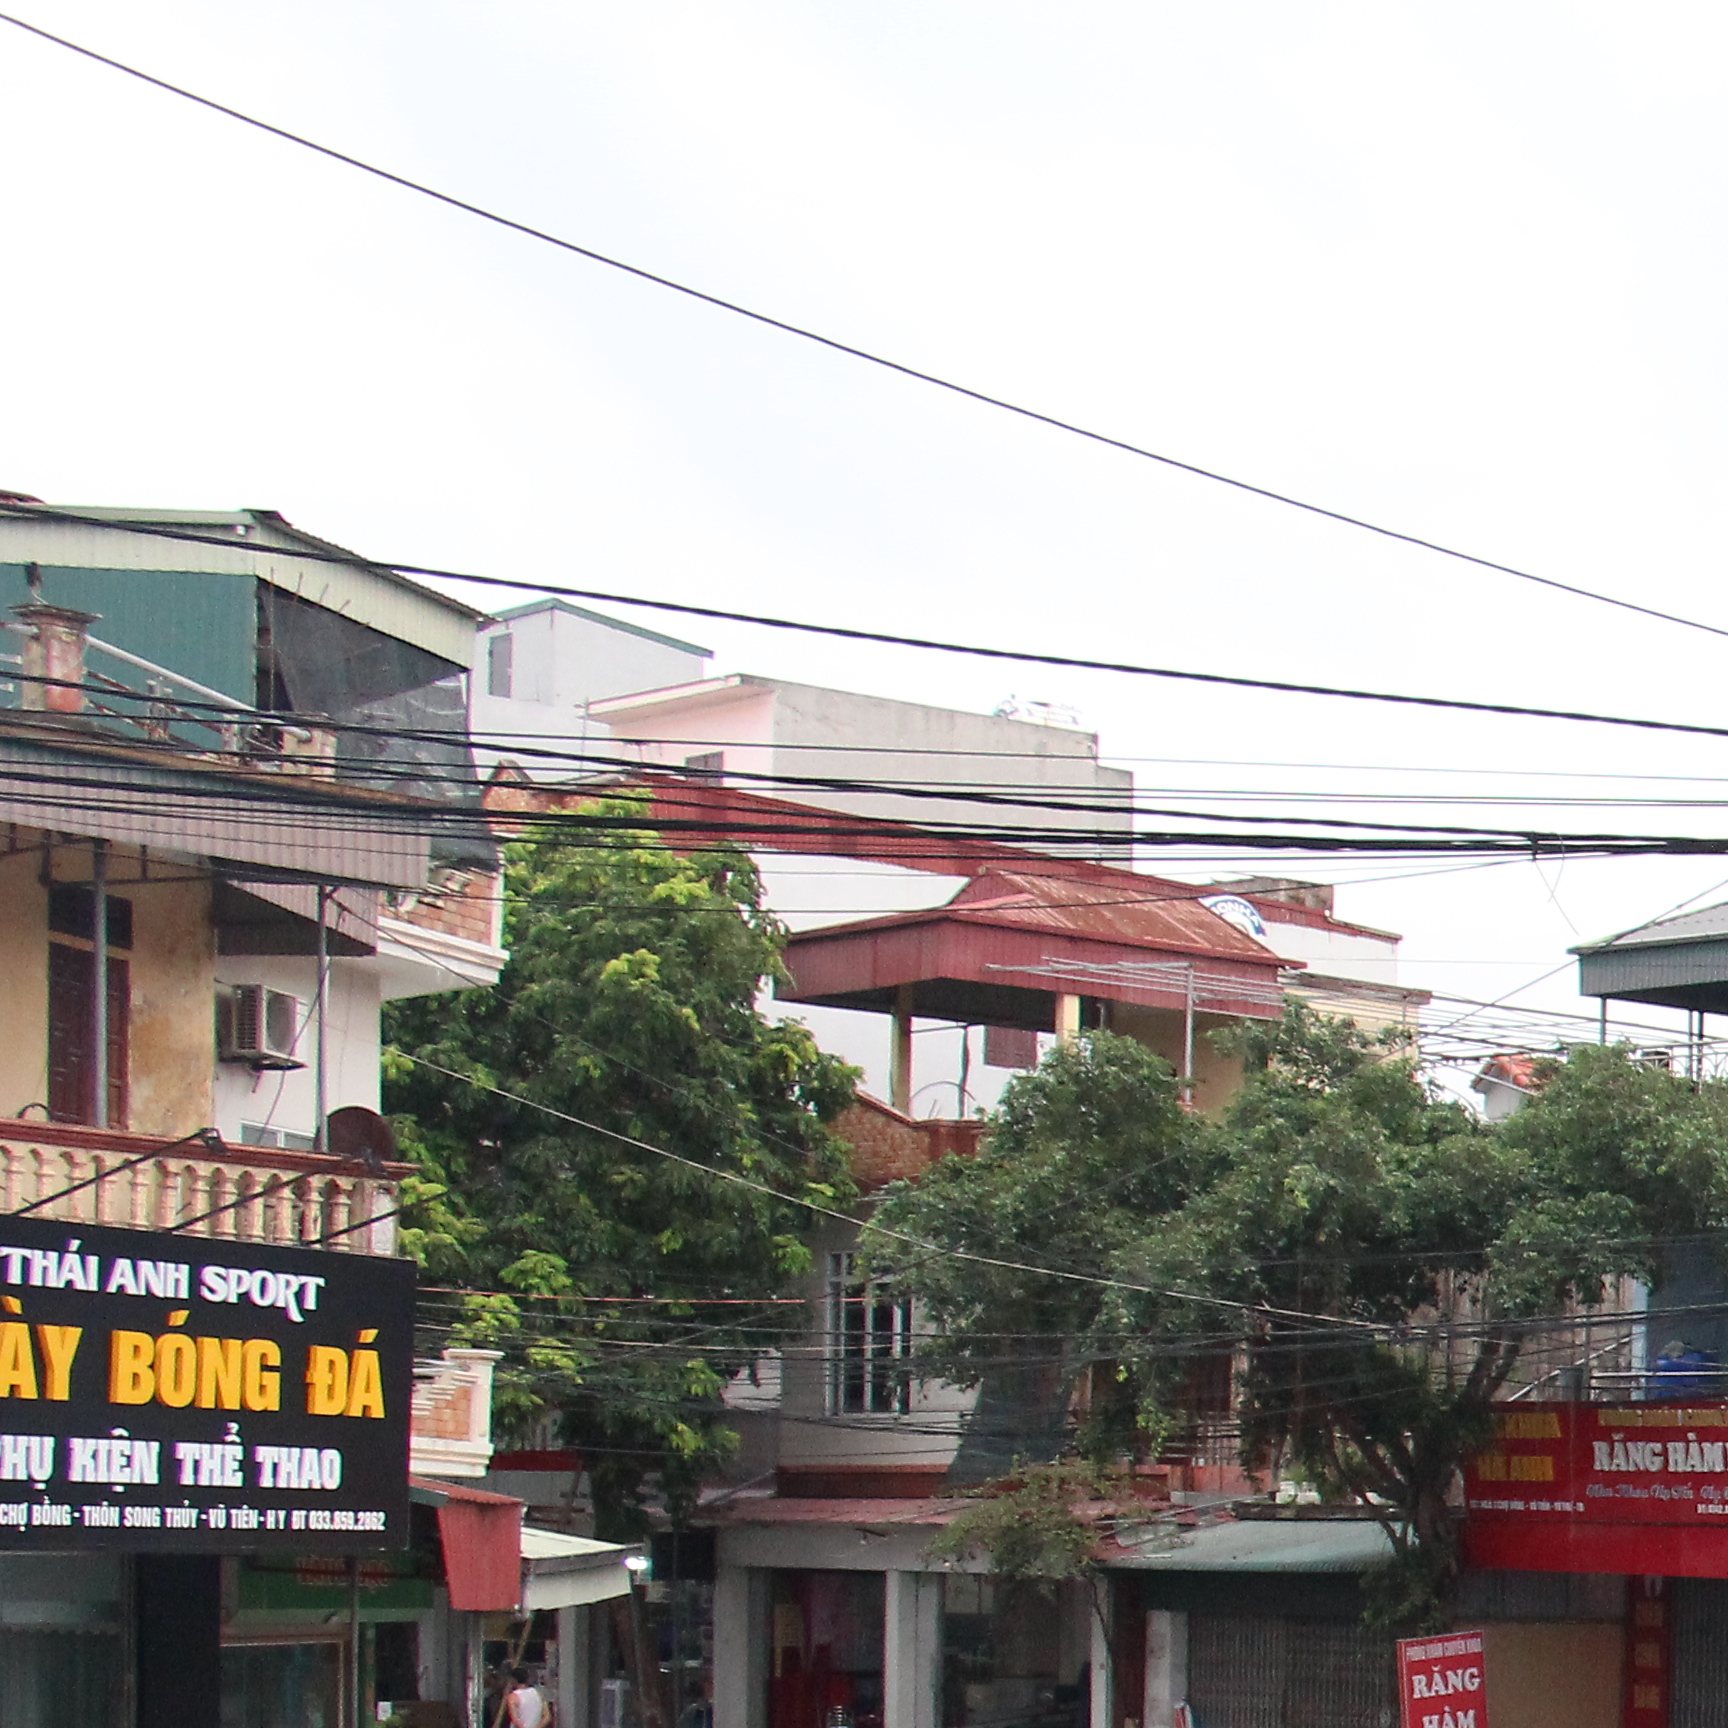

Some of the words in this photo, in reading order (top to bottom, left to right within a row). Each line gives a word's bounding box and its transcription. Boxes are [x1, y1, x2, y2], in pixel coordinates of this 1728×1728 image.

[0, 1238, 99, 1292] THÁI
[106, 1256, 190, 1299] ANH
[200, 1264, 325, 1322] SPORT
[108, 1309, 282, 1411] BÓNG
[305, 1328, 385, 1418] ĐÁ
[67, 1427, 160, 1492] KIỆN
[175, 1421, 244, 1487] THỂ
[255, 1446, 342, 1491] THAO
[1592, 1433, 1664, 1472] RĂNG
[1667, 1432, 1725, 1473] HÀM
[82, 1500, 121, 1528] THÔN
[123, 1506, 161, 1529] SONG
[164, 1499, 199, 1529] THỦY
[208, 1503, 227, 1530] VŨ
[229, 1504, 259, 1530] TIÊN
[1412, 1665, 1481, 1699] RĂNG
